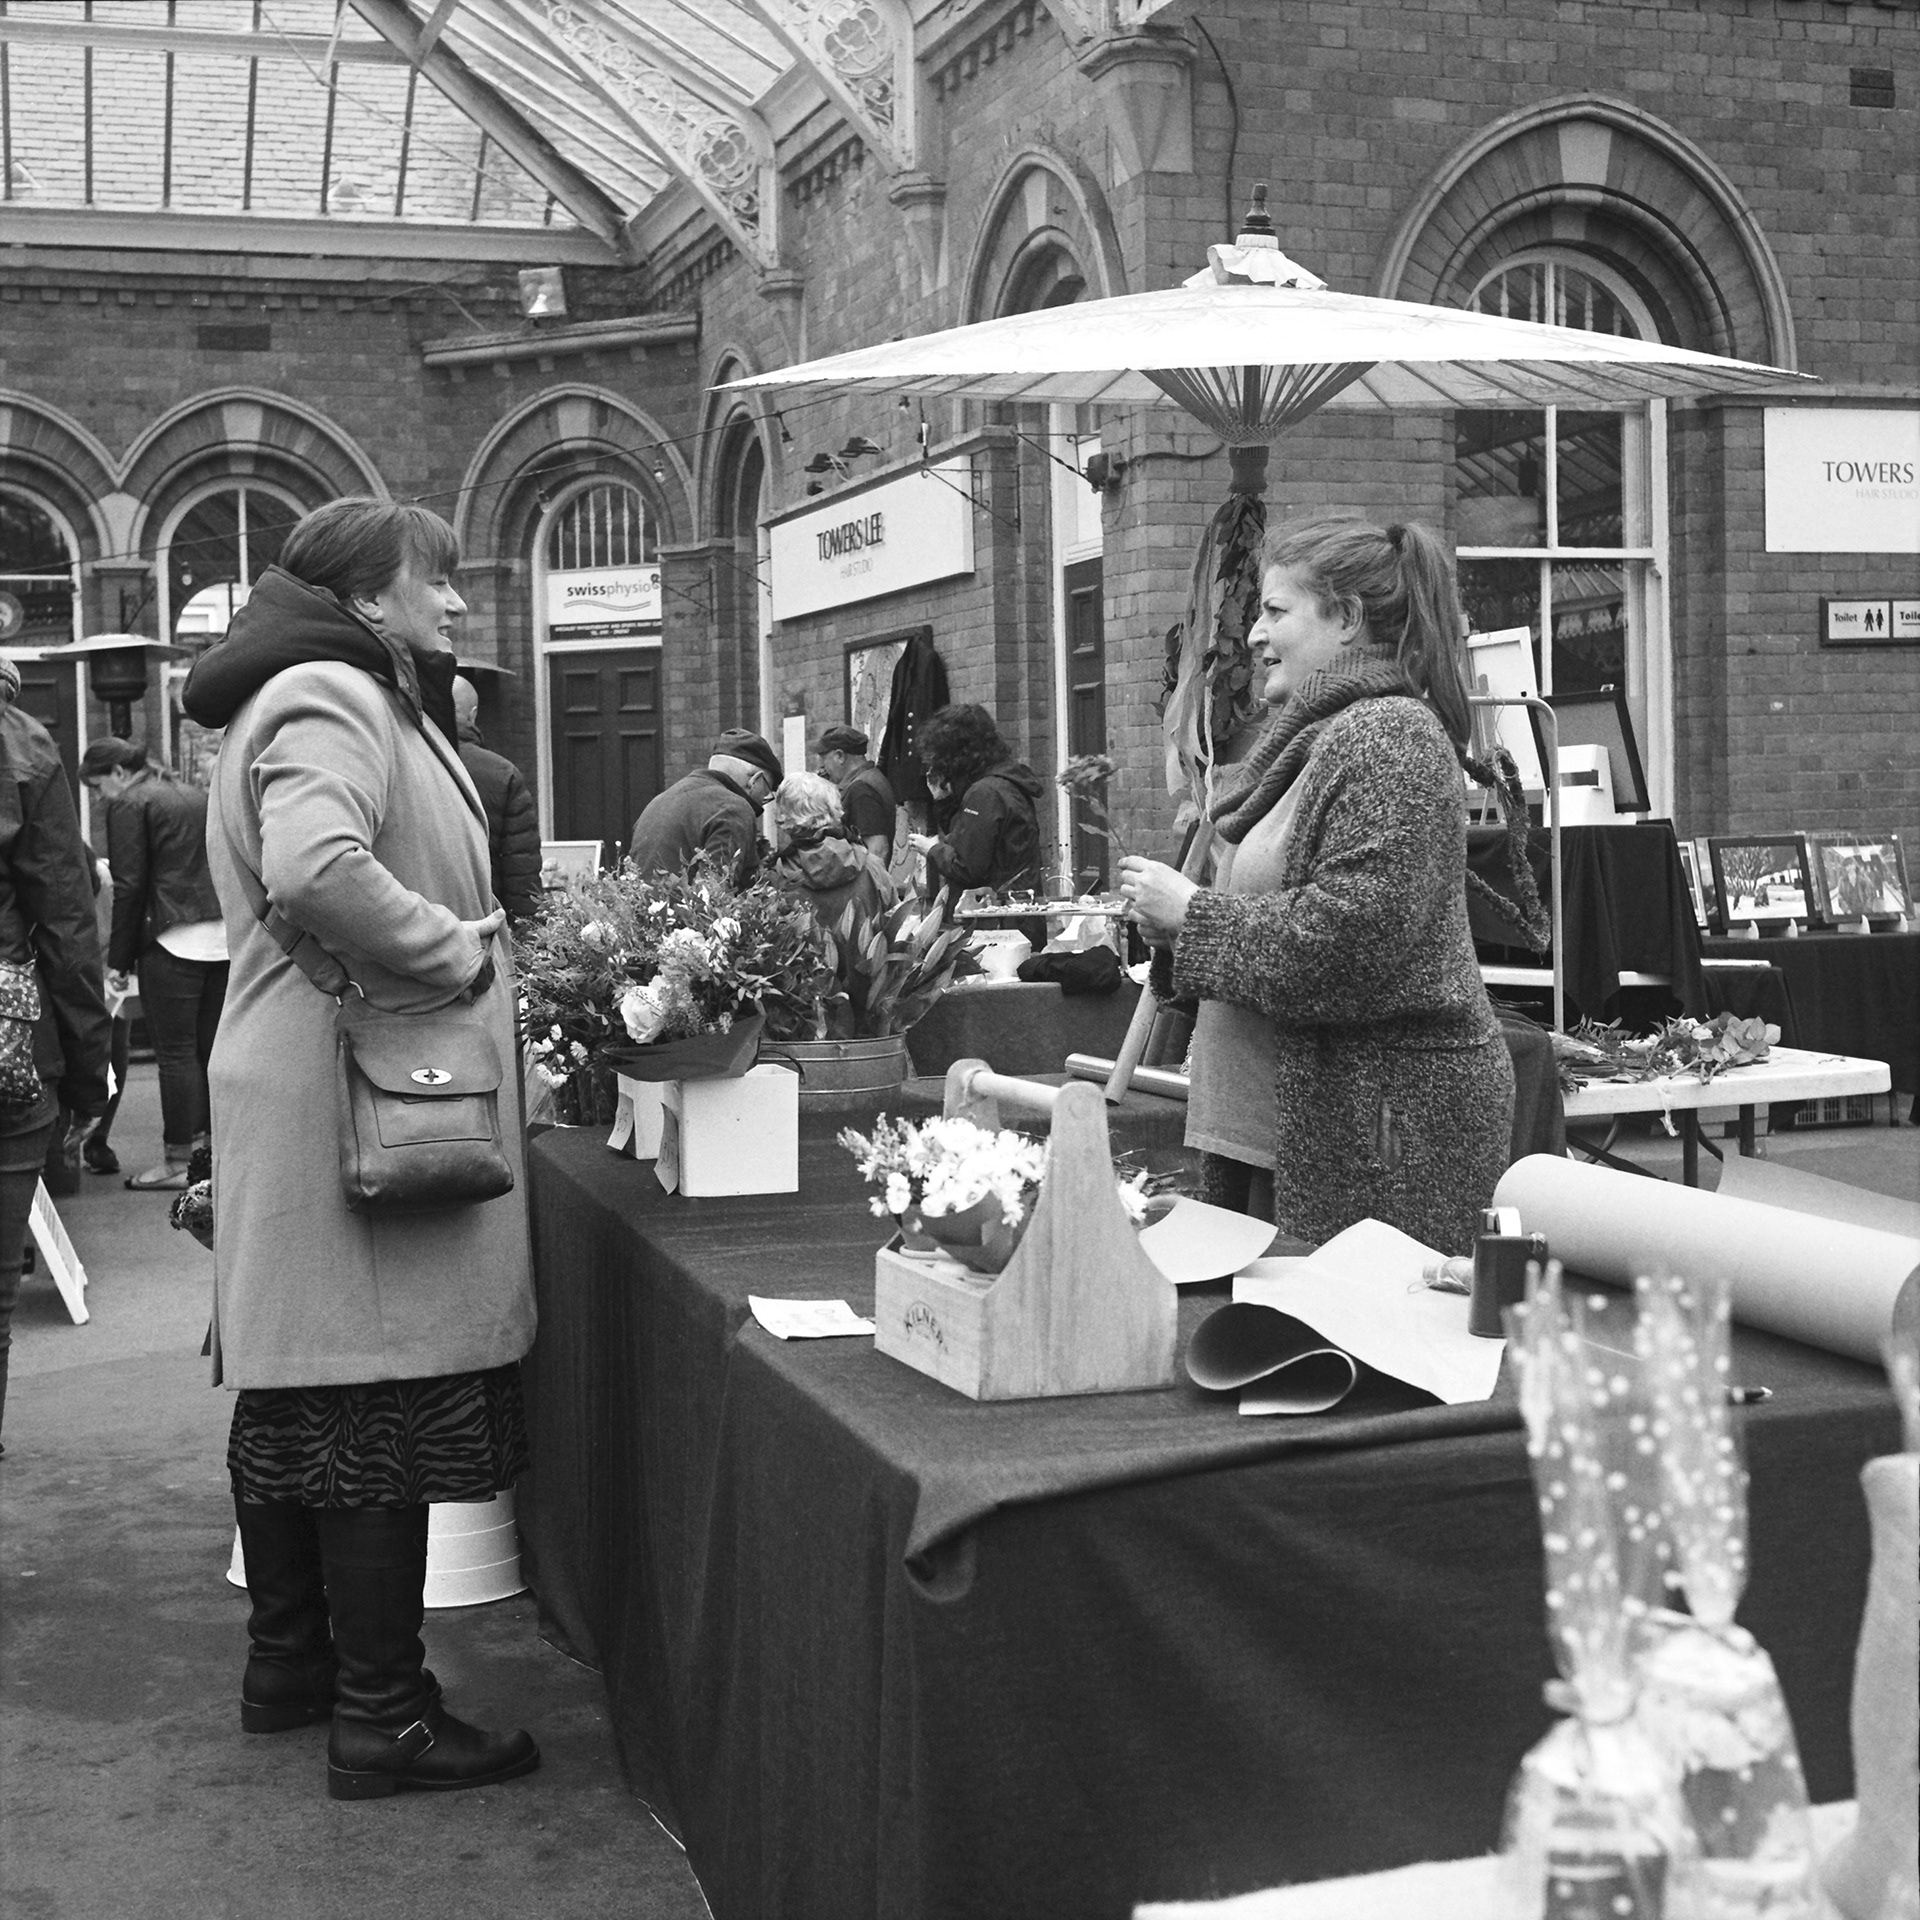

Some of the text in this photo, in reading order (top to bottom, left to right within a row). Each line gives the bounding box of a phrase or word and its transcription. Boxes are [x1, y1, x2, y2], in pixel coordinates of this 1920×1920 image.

[1822, 461, 1914, 484] TOWERS
[1855, 488, 1880, 499] HAIR
[816, 511, 884, 561] TOWERS LEE
[566, 580, 651, 598] swissphysio
[1833, 612, 1858, 623] Toilet
[903, 1306, 944, 1347] KILNER
